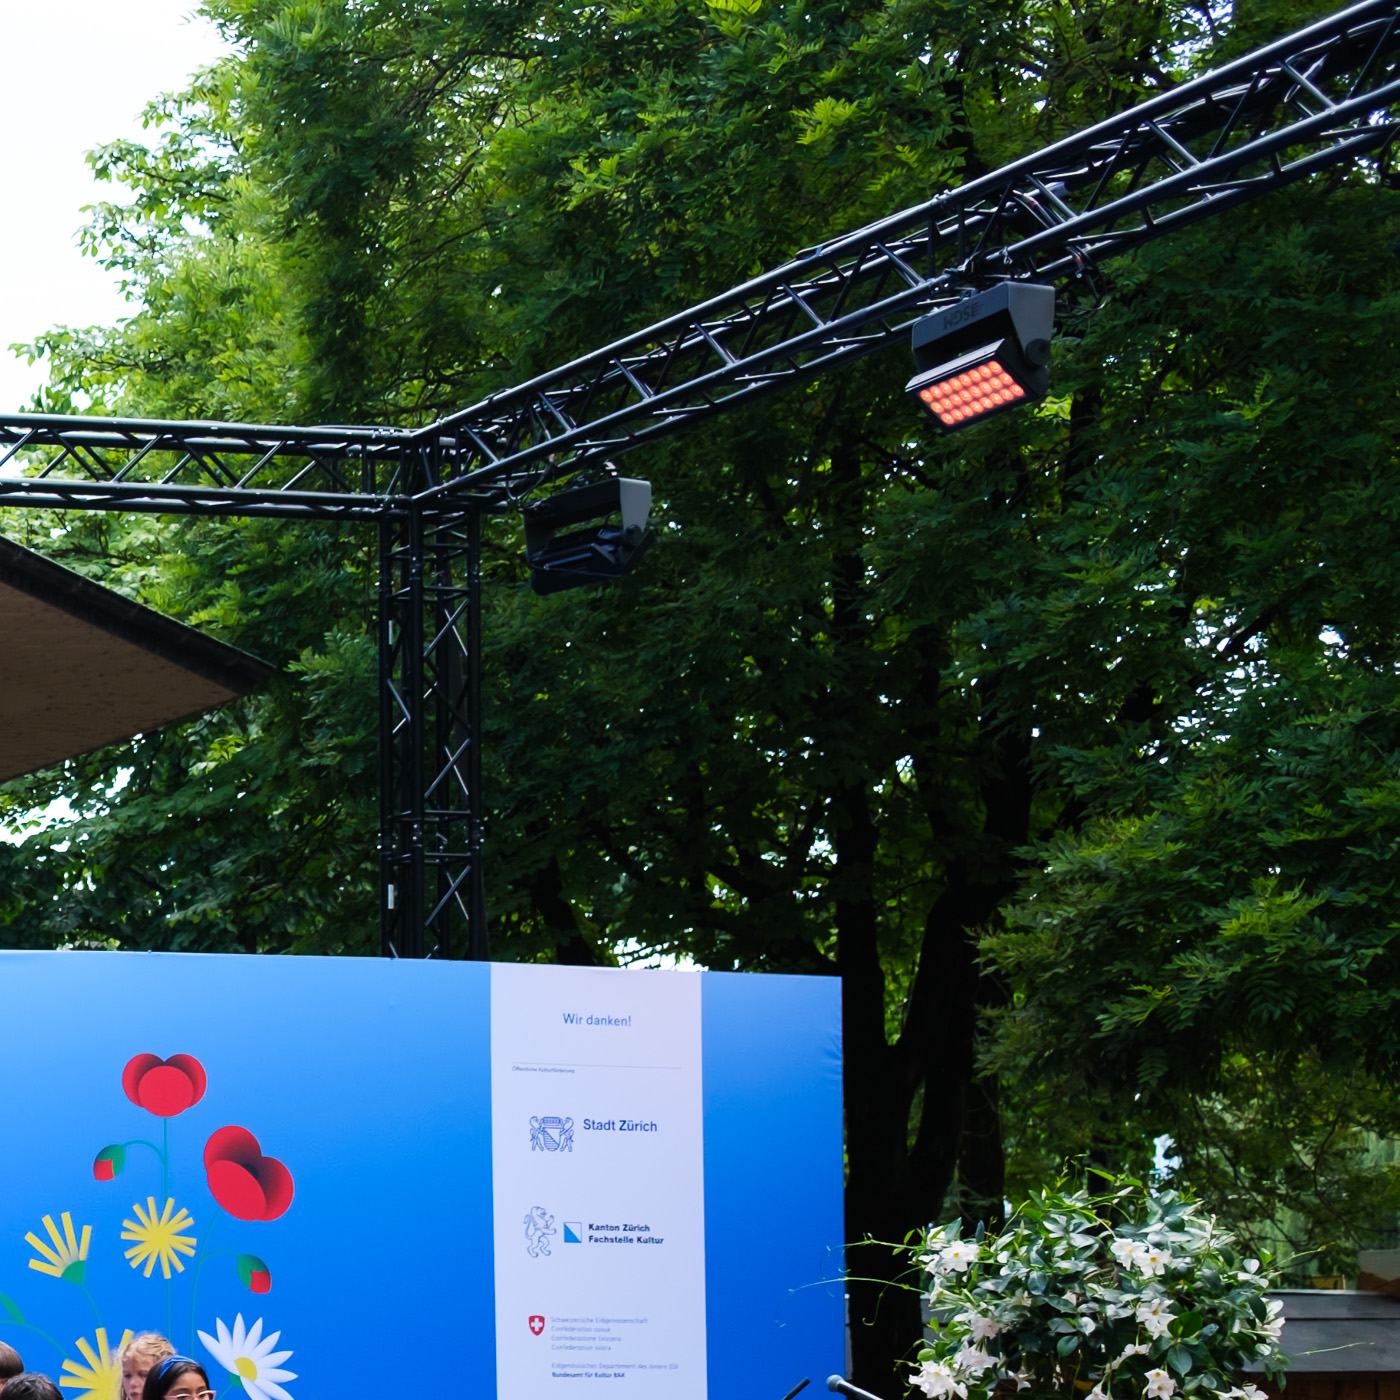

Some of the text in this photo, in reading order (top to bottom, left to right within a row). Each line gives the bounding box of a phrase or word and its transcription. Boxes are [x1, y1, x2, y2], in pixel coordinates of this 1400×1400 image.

[563, 1013, 632, 1027] Wir danken!
[583, 1119, 658, 1132] Stadt Zürich
[588, 1223, 650, 1232] Kanton Zürich
[588, 1235, 664, 1244] Fachstelle Kultur
